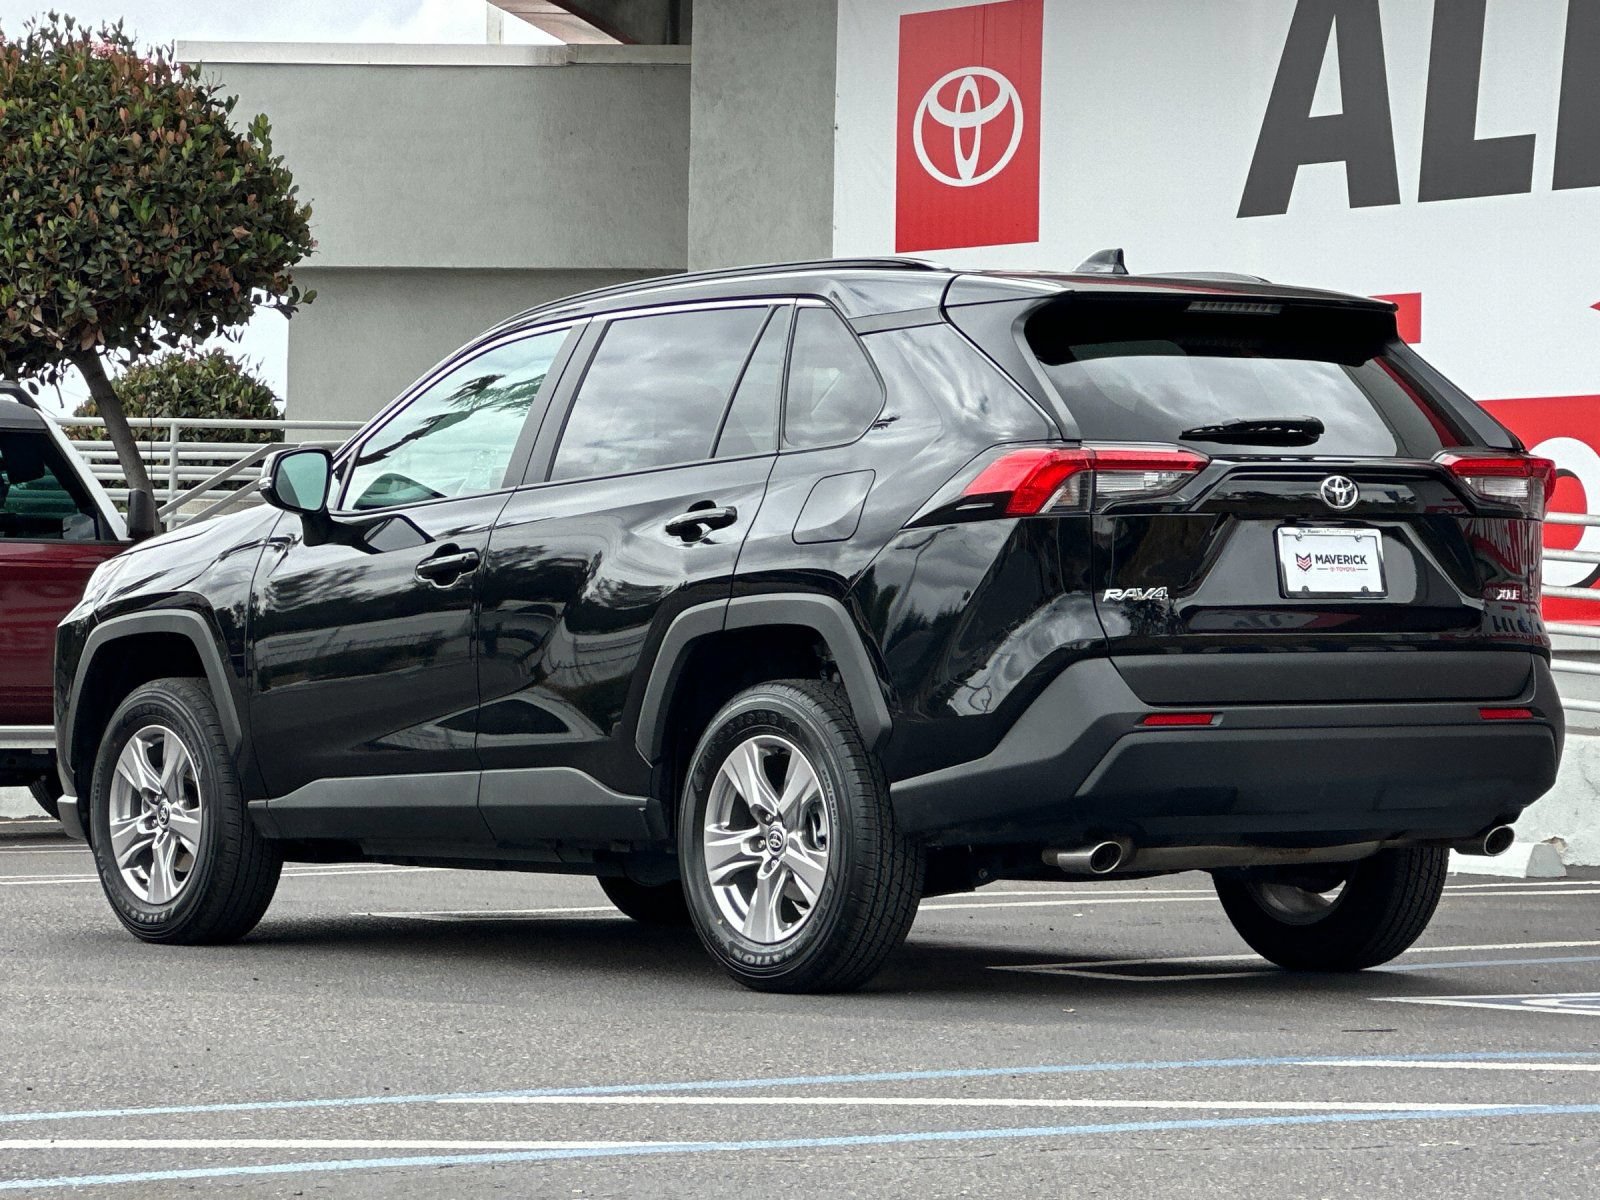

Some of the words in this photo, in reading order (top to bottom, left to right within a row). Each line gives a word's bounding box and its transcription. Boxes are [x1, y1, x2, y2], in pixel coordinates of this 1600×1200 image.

[1315, 554, 1367, 565] MAVERICK
[1102, 586, 1169, 602] RAV4
[1496, 589, 1520, 600] XLE
